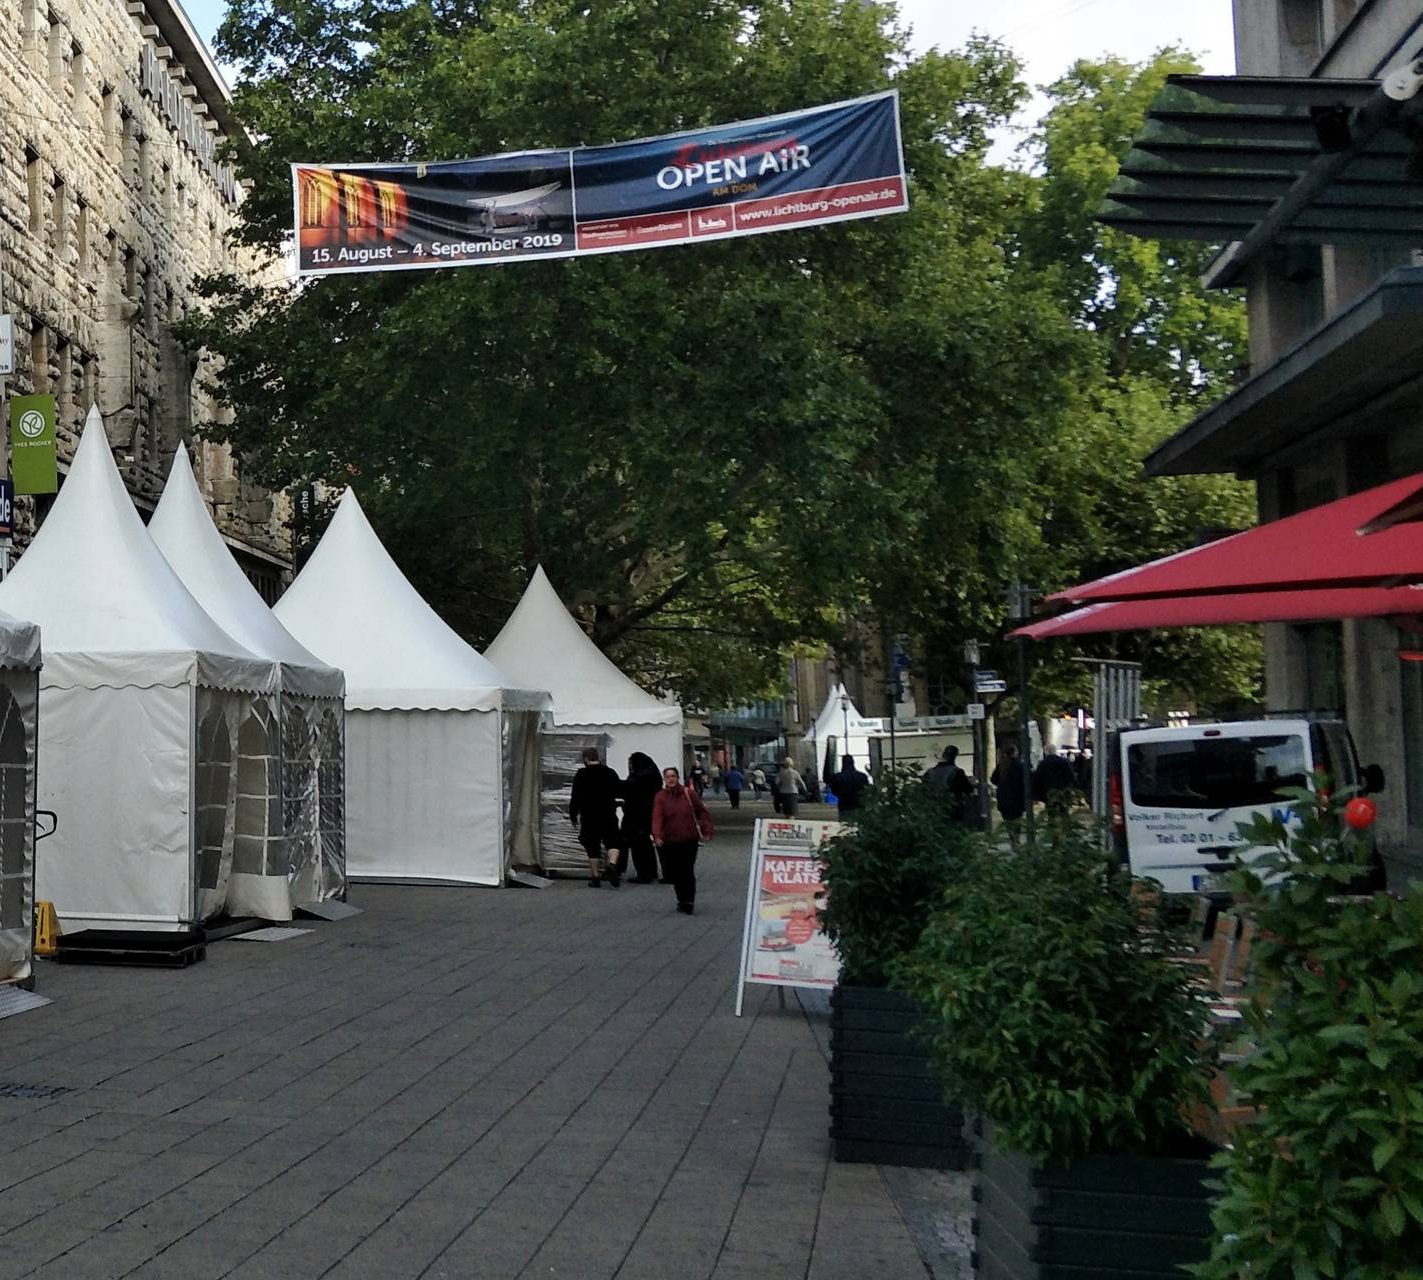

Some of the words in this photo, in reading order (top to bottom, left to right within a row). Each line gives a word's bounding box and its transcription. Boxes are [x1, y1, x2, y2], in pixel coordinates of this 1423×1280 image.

[656, 155, 748, 191] OPEN
[739, 188, 897, 222] www.lichtburg-openair.de
[312, 248, 334, 263] 15.
[338, 247, 393, 264] August
[412, 243, 427, 257] 4.
[431, 237, 519, 258] September
[523, 233, 563, 248] 2019
[772, 872, 822, 884] KLATS
